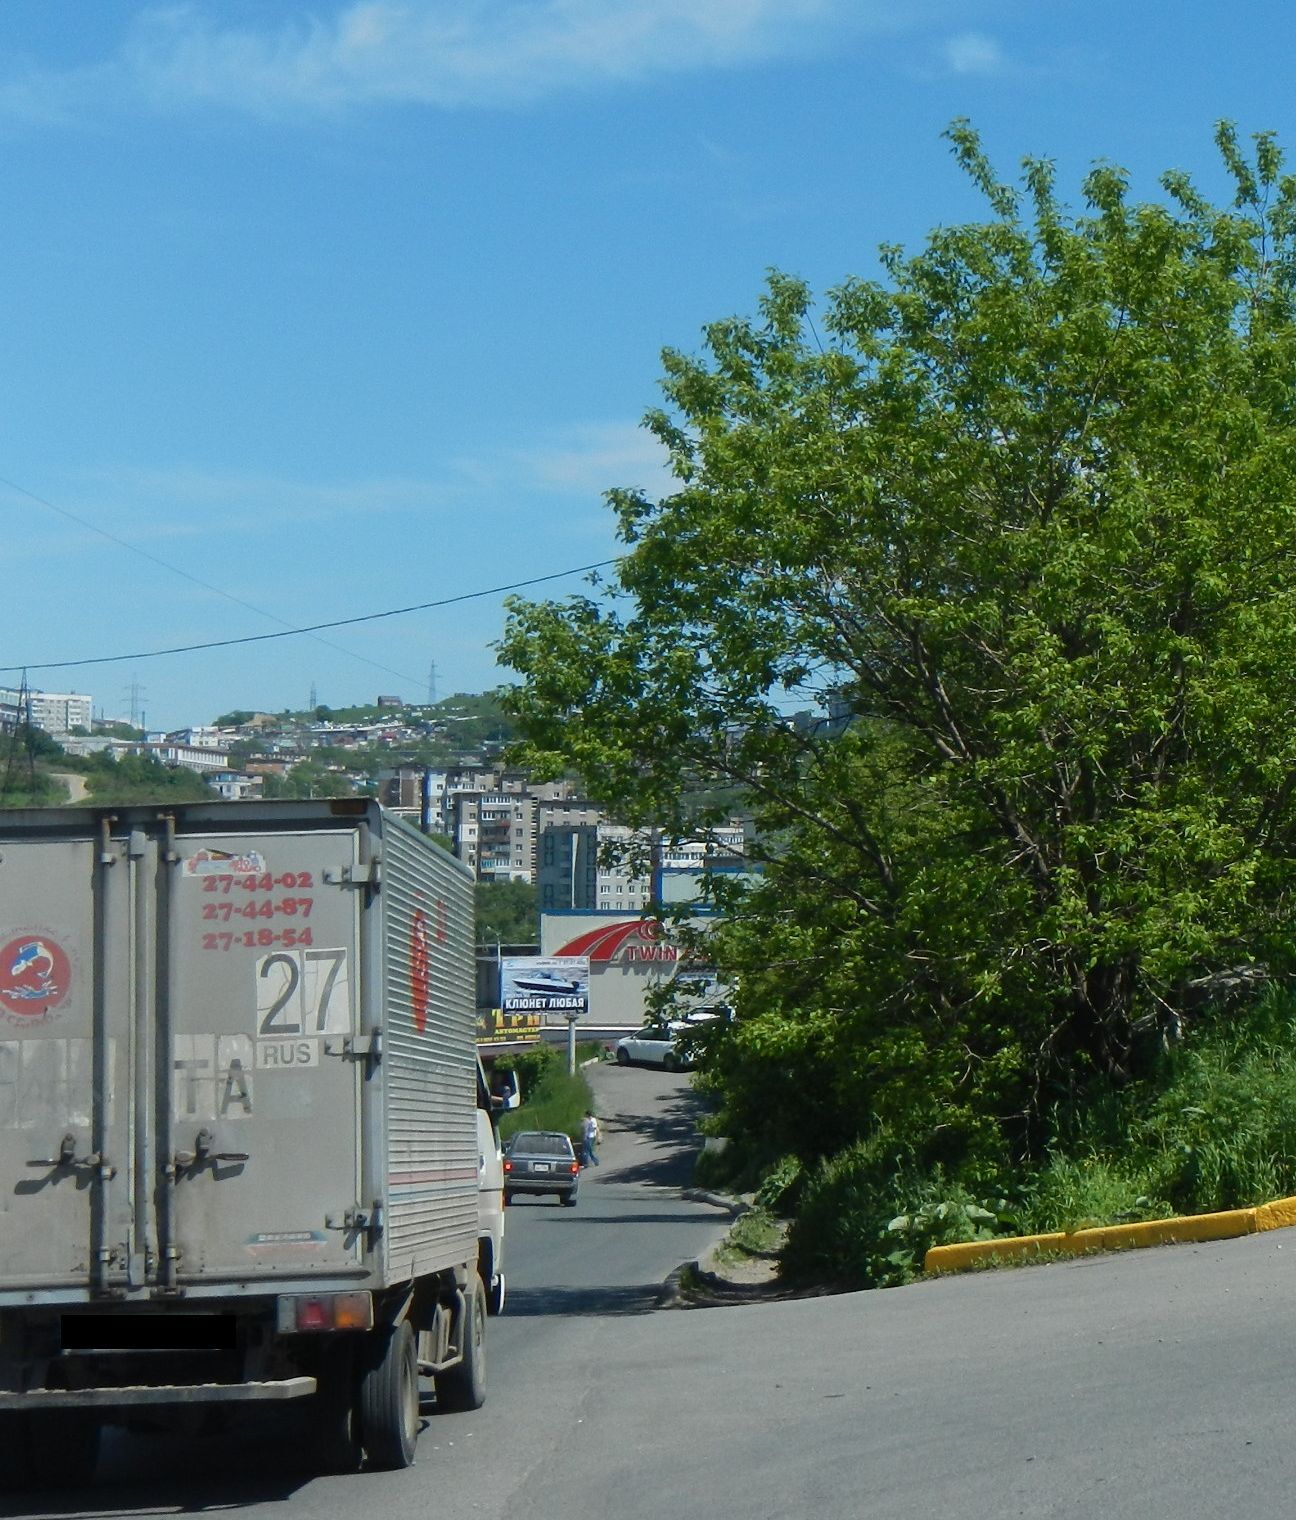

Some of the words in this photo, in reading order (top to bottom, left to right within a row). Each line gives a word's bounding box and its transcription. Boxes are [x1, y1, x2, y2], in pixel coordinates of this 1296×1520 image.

[202, 872, 313, 894] 27-44-02
[202, 898, 313, 921] 27-44-87
[202, 927, 313, 951] 27-18-54
[626, 945, 678, 961] TWIN
[259, 949, 348, 1037] 27
[505, 998, 547, 1009] КЛЮНЕТ
[548, 997, 584, 1008] ЛЮБАЯ
[263, 1043, 311, 1065] RUS
